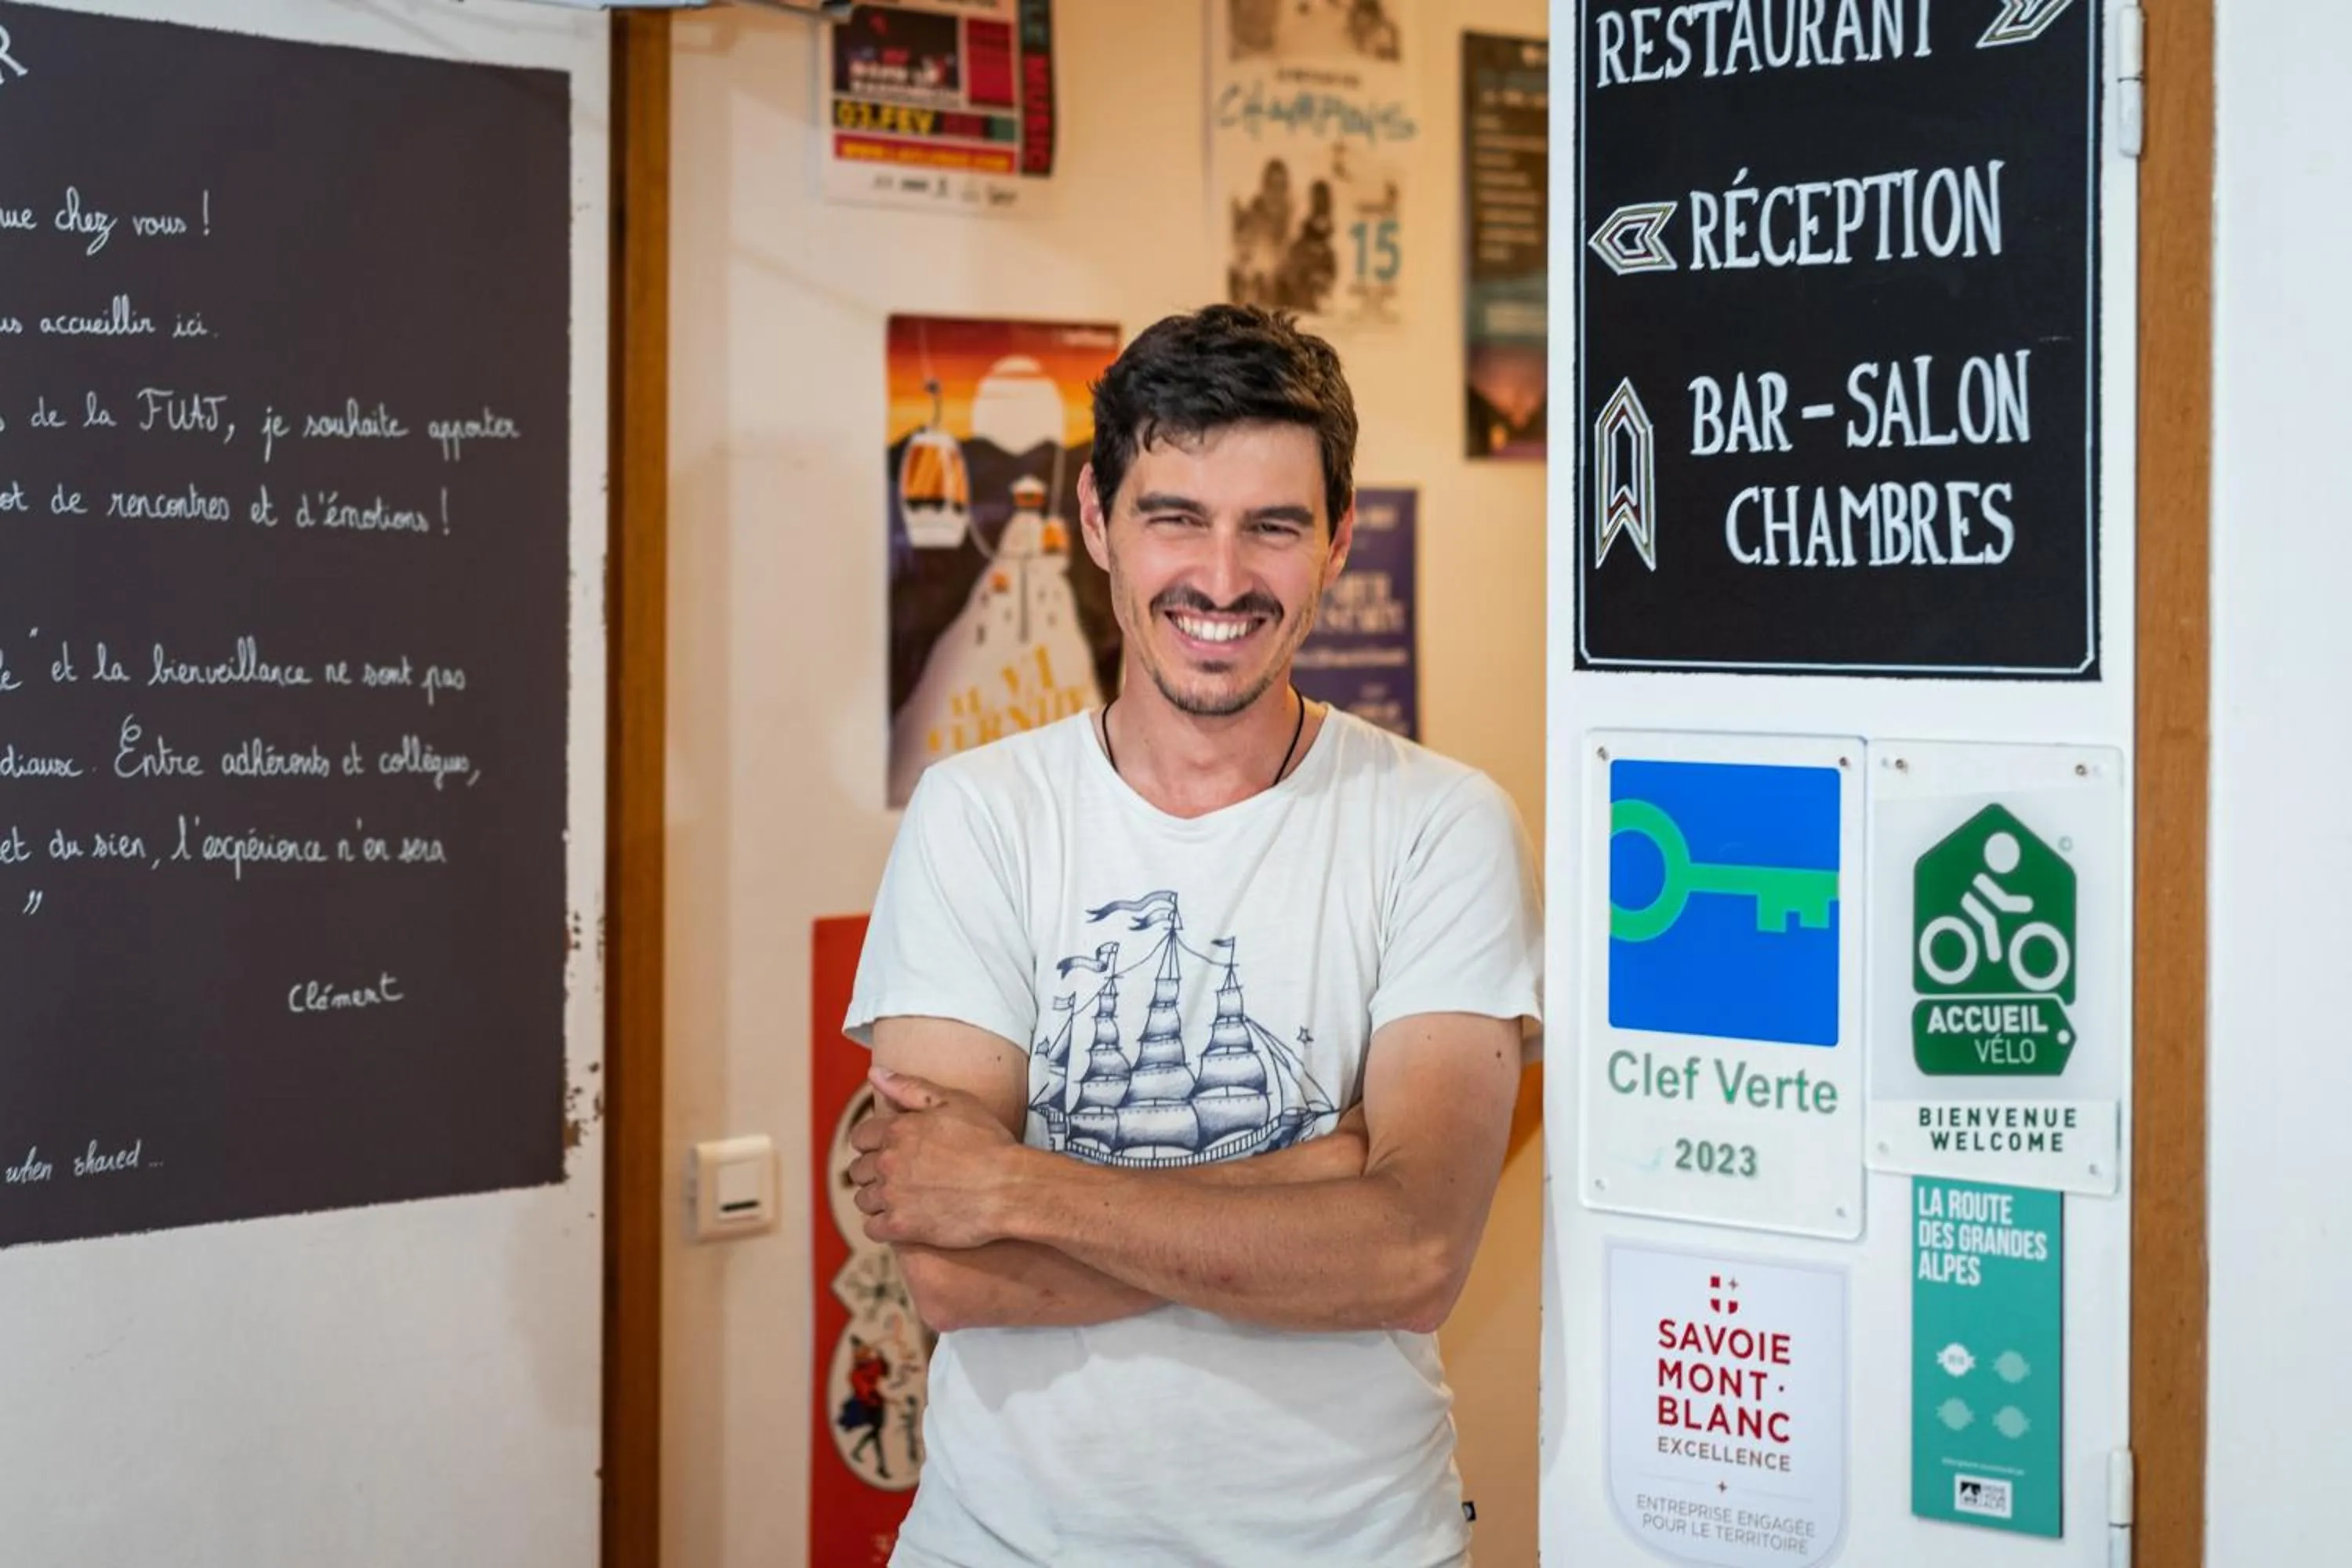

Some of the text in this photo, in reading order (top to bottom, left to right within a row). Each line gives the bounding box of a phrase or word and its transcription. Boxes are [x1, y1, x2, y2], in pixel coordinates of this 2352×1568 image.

[1596, 0, 1932, 88] RESTAURANT
[55, 187, 118, 256] chez
[132, 216, 187, 235] vous
[1690, 159, 2005, 270] RÉCEPTION
[1349, 221, 1400, 281] 15
[40, 294, 155, 335] accueillir
[1688, 372, 1792, 455] BAR
[1847, 350, 2031, 447] SALON
[31, 397, 66, 427] de
[83, 391, 116, 426] la
[262, 407, 289, 463] je
[303, 398, 408, 438] souhaite
[428, 408, 520, 460] apporter
[51, 484, 87, 514] de
[107, 484, 230, 521] rencontres
[251, 485, 278, 526] et
[296, 492, 429, 532] d'émotions
[1726, 481, 2014, 567] CHAMBRES
[52, 641, 77, 682] et
[93, 642, 130, 681] la
[147, 636, 312, 686] bienveillance
[325, 662, 351, 684] ne
[362, 656, 412, 686] sont
[421, 666, 465, 705] pas
[114, 714, 203, 778] Entre
[222, 738, 329, 777] adhérents
[343, 742, 364, 775] et
[0, 826, 31, 863] et
[49, 829, 83, 860] du
[93, 834, 159, 869] sien,
[171, 815, 327, 880] l'expérience
[398, 838, 445, 862] sera
[289, 973, 402, 1012] Clément
[1927, 1007, 2048, 1033] ACCUEIL
[1974, 1036, 2036, 1064] VÉLO
[1608, 1051, 1838, 1113] Clef Verte
[1919, 1108, 2075, 1127] BIENVENUE
[1675, 1138, 1757, 1178] 2023
[1931, 1131, 2062, 1152] WELCOME
[6, 1146, 52, 1183] when
[1918, 1186, 2013, 1225] LA ROUTE
[1918, 1218, 2048, 1261] DES GRANDES
[1918, 1250, 1982, 1286] ALPES
[1658, 1319, 1791, 1364] SAVOIE
[1658, 1359, 1768, 1398] MONT
[1658, 1397, 1791, 1443] BLANC
[1658, 1436, 1791, 1472] EXCELLENCE
[1637, 1494, 1731, 1523] ENTREPRISE
[1642, 1514, 1809, 1555] POUR LE TERRITOIRE
